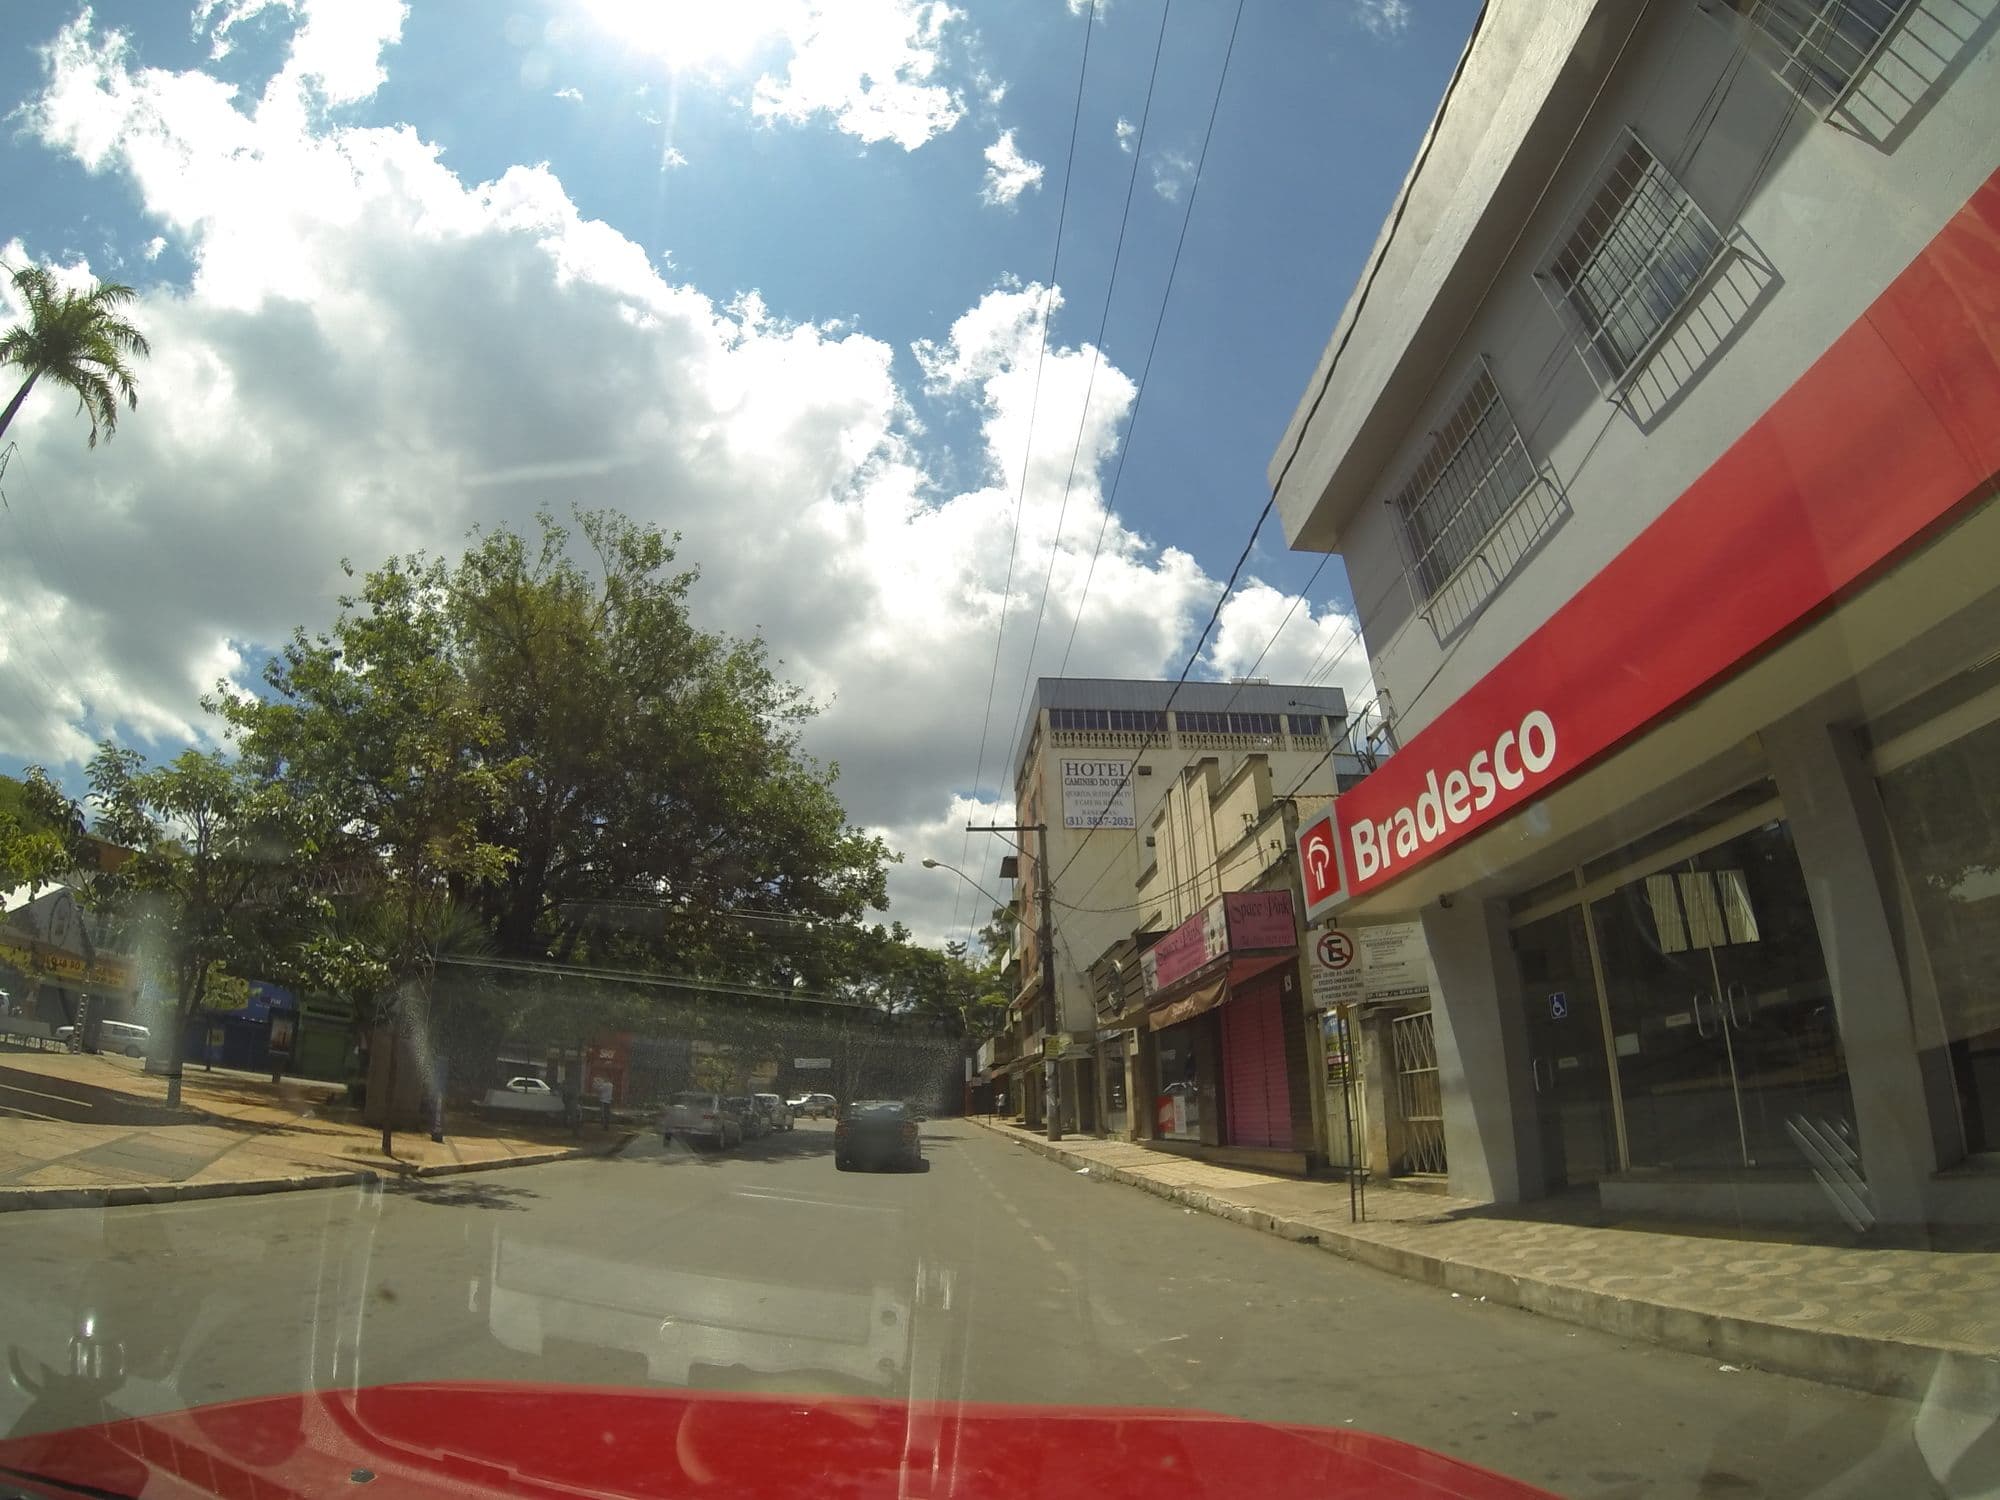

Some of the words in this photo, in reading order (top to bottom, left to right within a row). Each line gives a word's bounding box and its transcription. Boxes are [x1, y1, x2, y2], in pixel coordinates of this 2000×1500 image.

[1065, 763, 1127, 777] HOTEL
[1064, 777, 1098, 786] CAMINHO
[1099, 778, 1110, 787] DO
[1351, 710, 1556, 882] Bradesco
[1065, 816, 1083, 826] (31)
